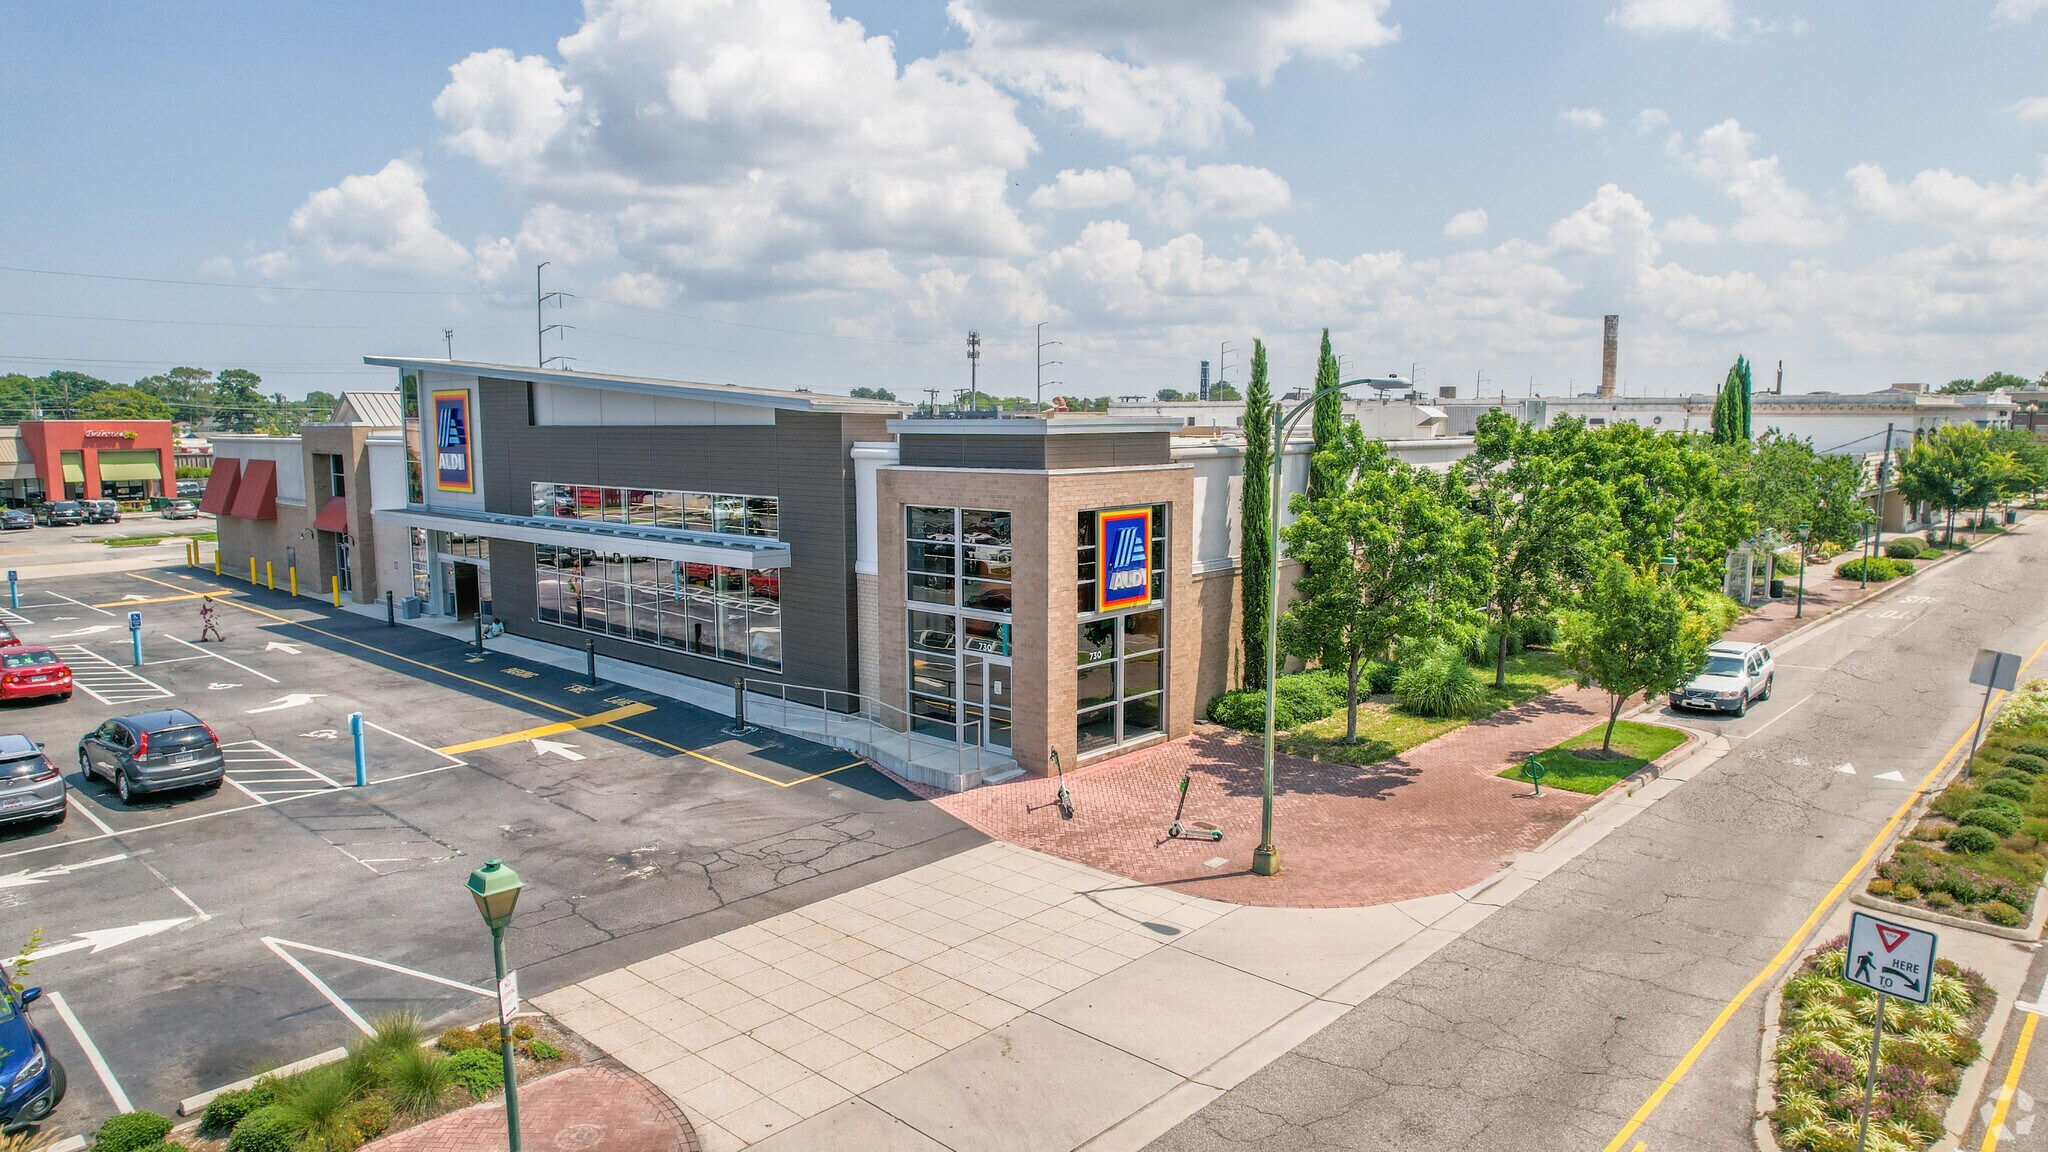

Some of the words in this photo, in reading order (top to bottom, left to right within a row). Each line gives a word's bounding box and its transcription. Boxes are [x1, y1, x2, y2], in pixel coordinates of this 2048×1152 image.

[439, 453, 465, 471] ALDI
[1109, 568, 1147, 591] ALDI
[978, 642, 993, 653] 730
[1089, 651, 1102, 661] 730
[1892, 958, 1920, 975] HERE
[1879, 976, 1893, 988] TO
